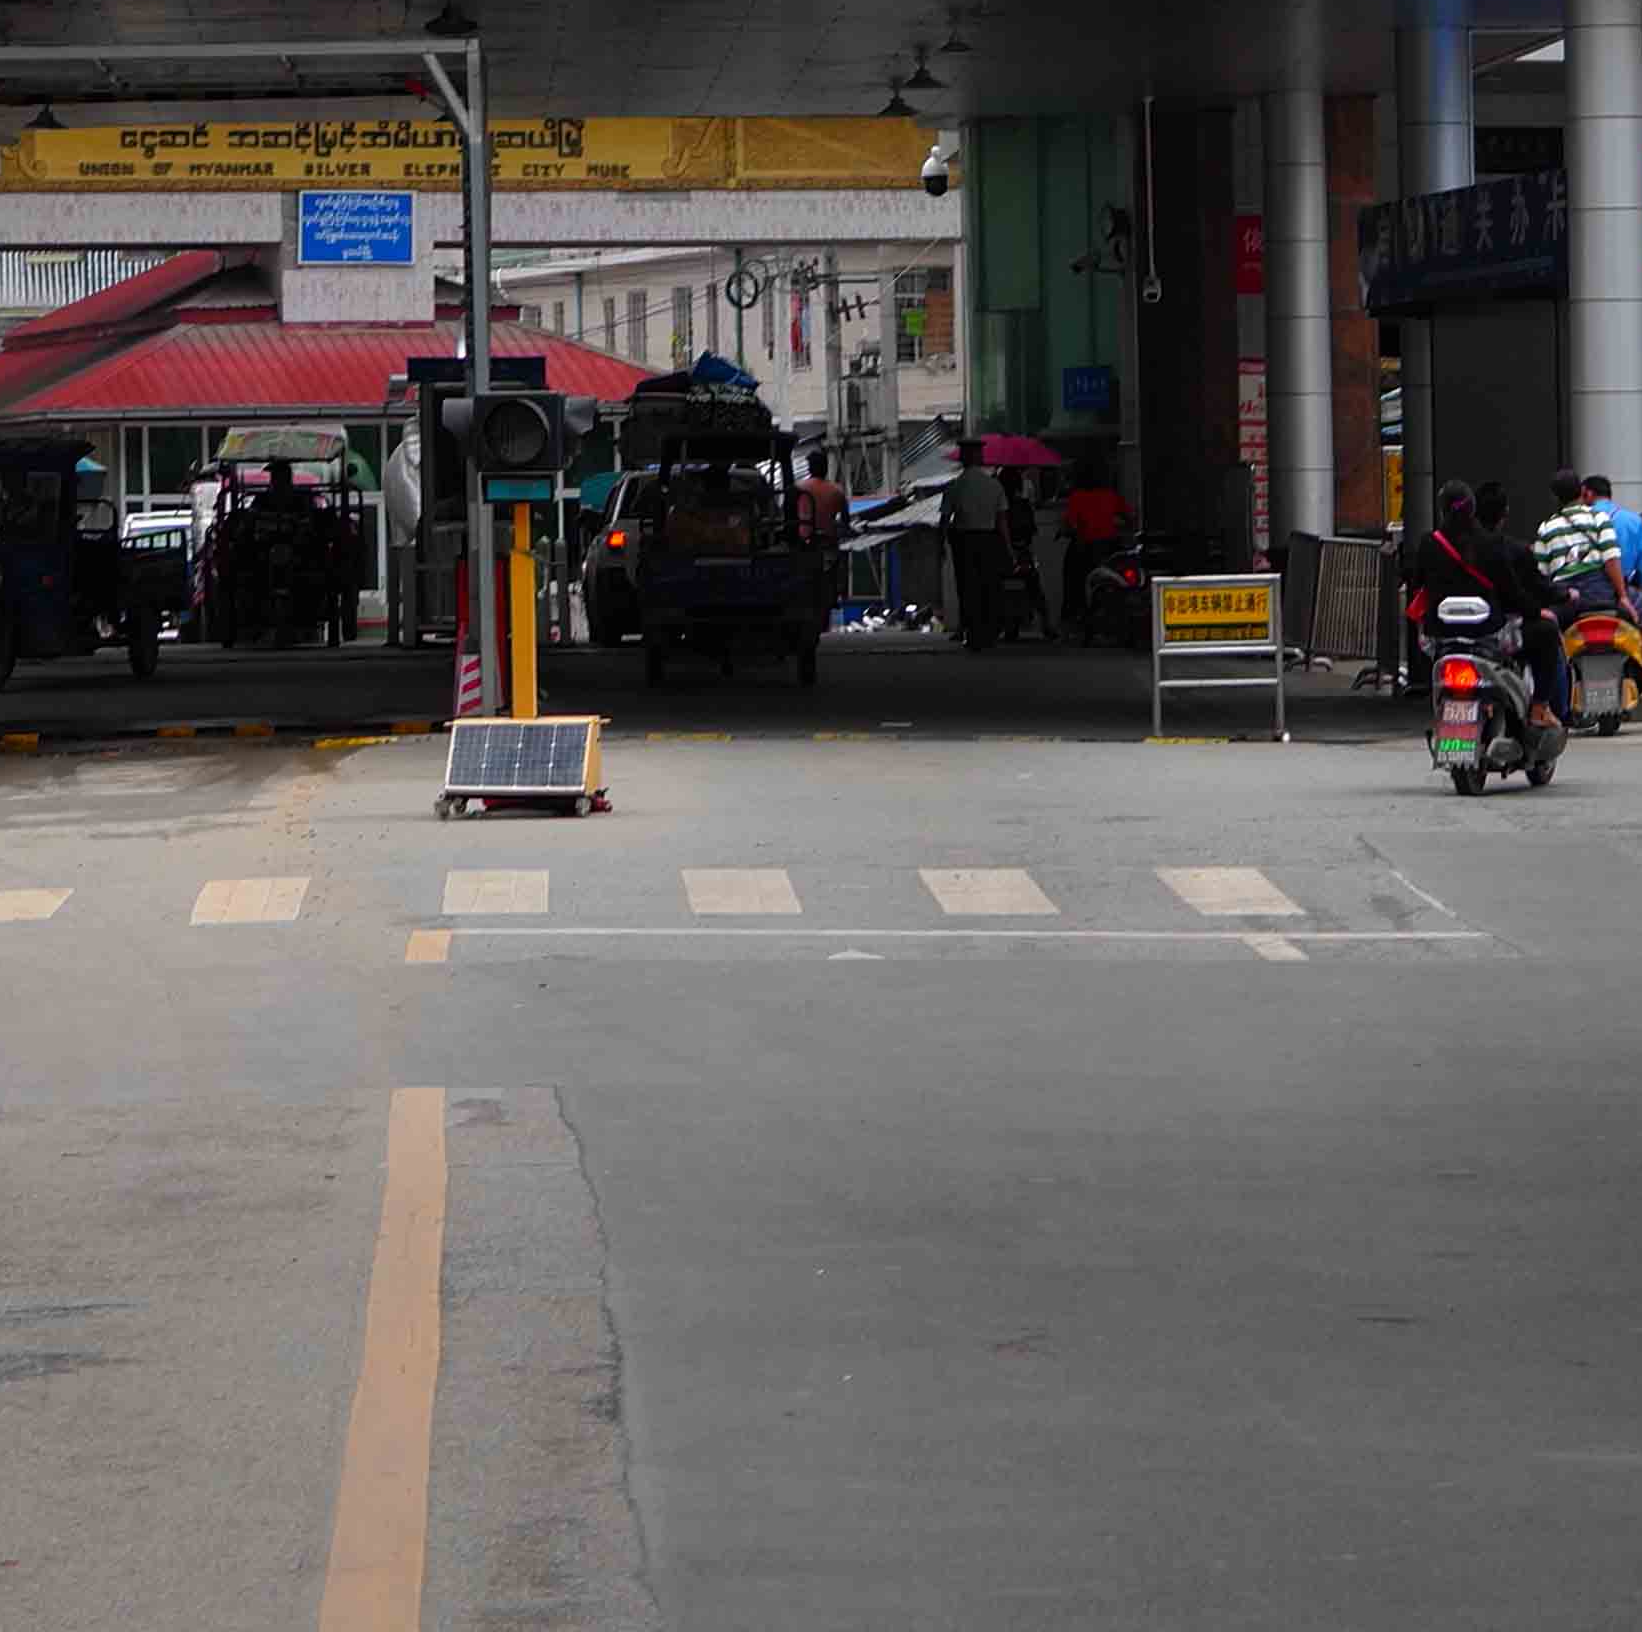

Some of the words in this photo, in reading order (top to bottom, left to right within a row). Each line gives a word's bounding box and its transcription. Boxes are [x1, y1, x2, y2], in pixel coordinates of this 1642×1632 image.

[79, 162, 134, 177] UNION
[152, 162, 173, 176] OF
[189, 162, 274, 177] MYANMAR
[304, 162, 371, 177] SILVER
[403, 163, 501, 177] ELEPHT
[521, 163, 566, 177] CITY
[586, 163, 631, 178] MUSE
